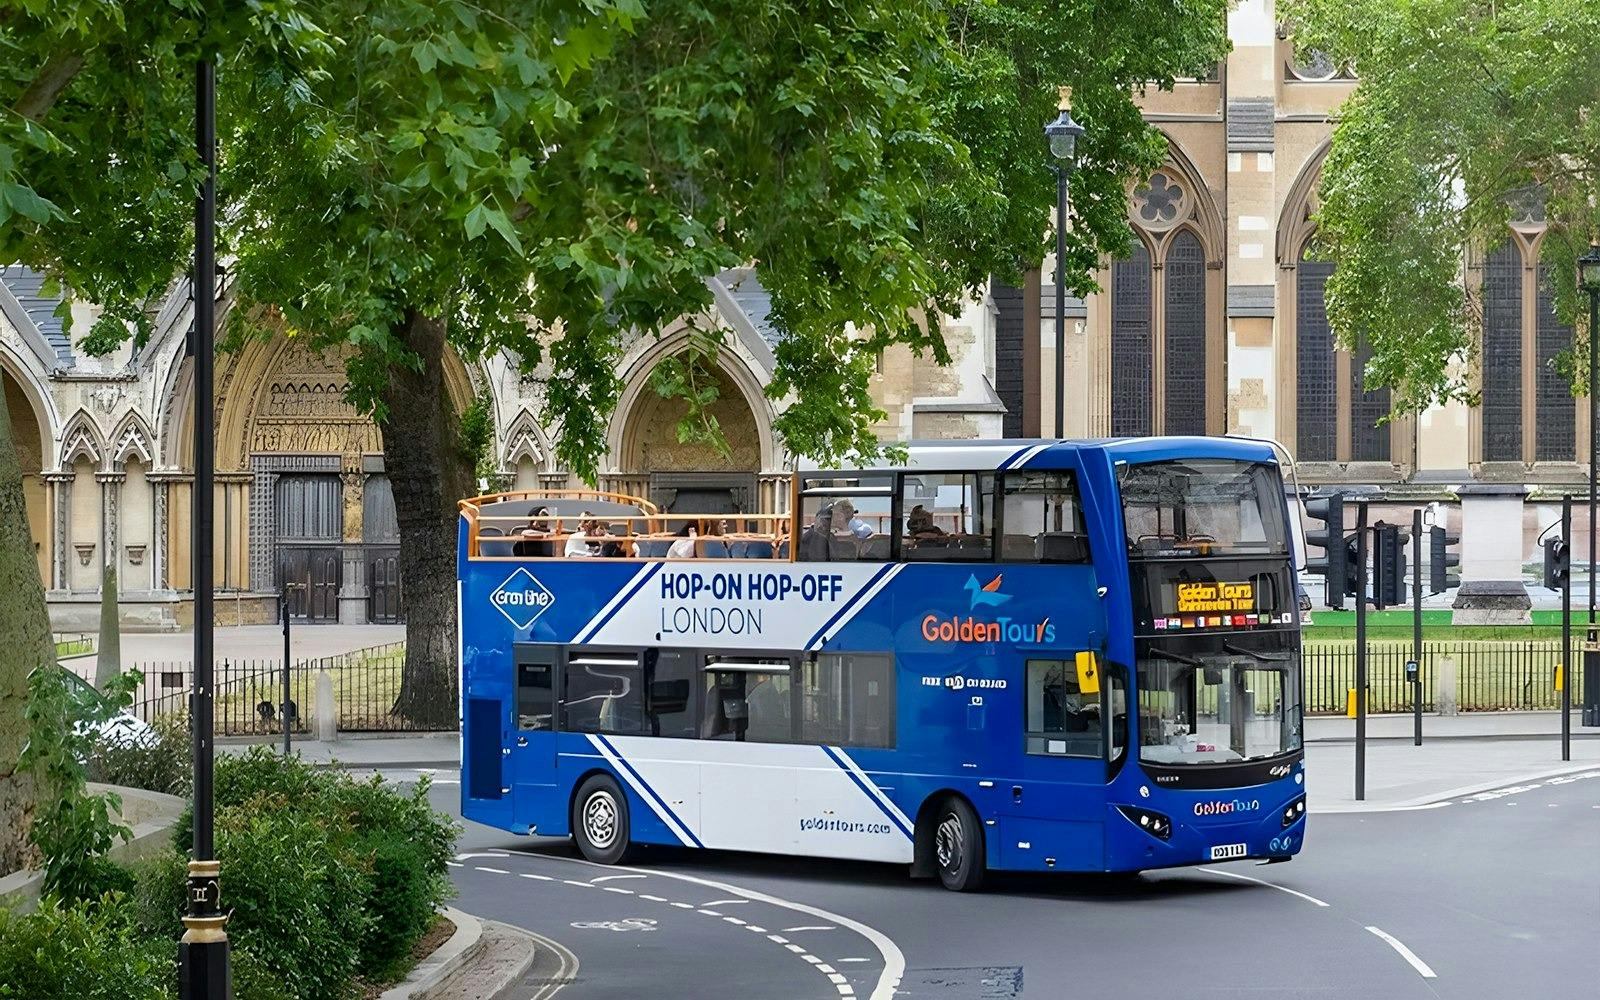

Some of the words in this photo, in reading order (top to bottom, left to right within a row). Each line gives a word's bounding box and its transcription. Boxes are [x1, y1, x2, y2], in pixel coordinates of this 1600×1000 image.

[661, 573, 742, 600] HOP-ON
[749, 573, 843, 602] HOP-OFF
[661, 606, 762, 635] LONDON
